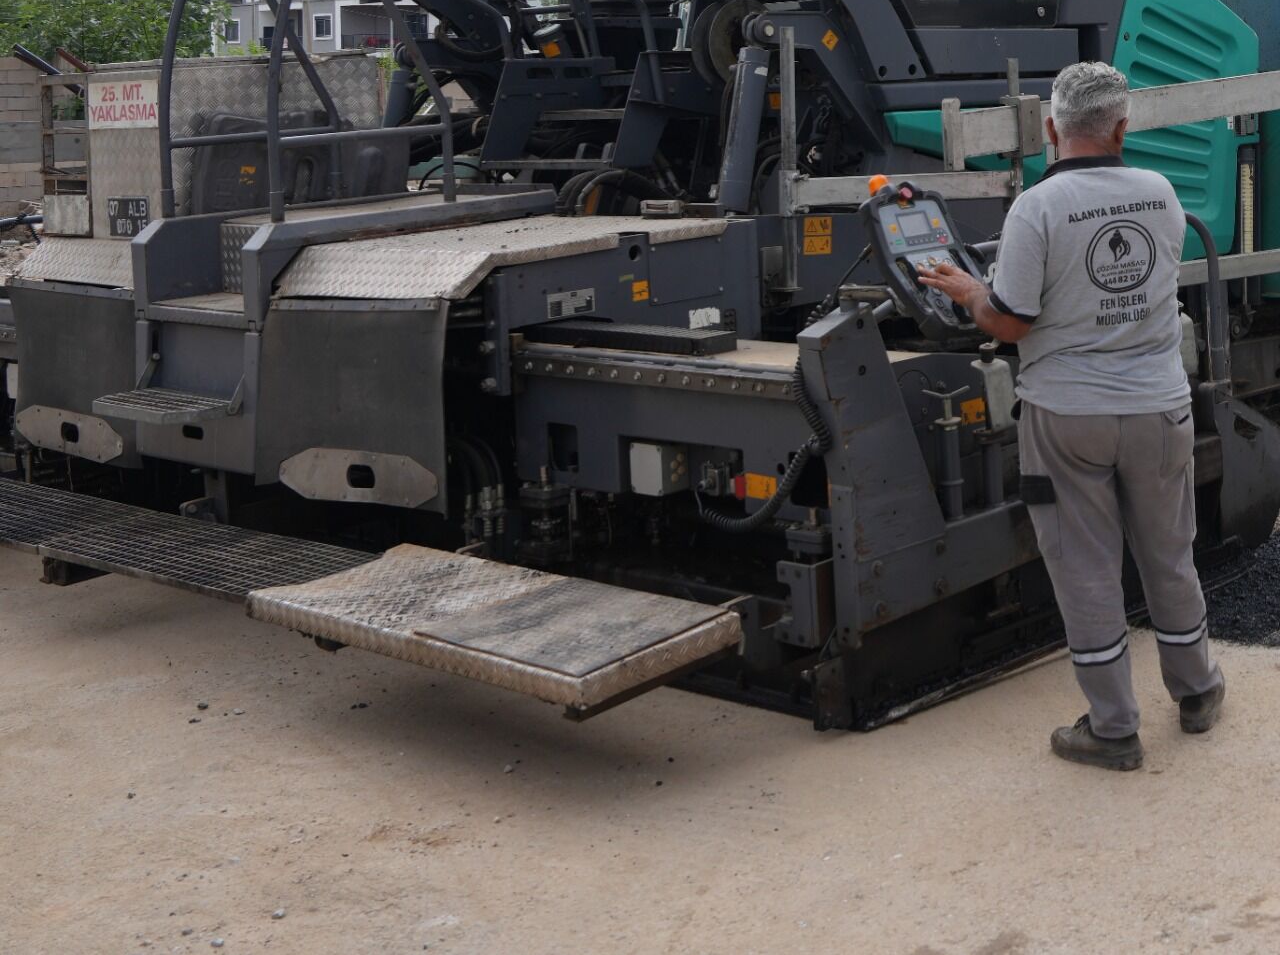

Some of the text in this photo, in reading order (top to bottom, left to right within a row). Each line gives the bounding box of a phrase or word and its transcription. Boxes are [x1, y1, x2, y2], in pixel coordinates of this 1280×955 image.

[101, 83, 144, 103] 25. MT.
[109, 200, 147, 217] 07 ALB
[1068, 199, 1167, 224] ALANYA BELEDİYESİ
[1118, 274, 1129, 284] 82
[1130, 273, 1141, 282] 07
[1100, 291, 1147, 311] FEN İŞLERİ
